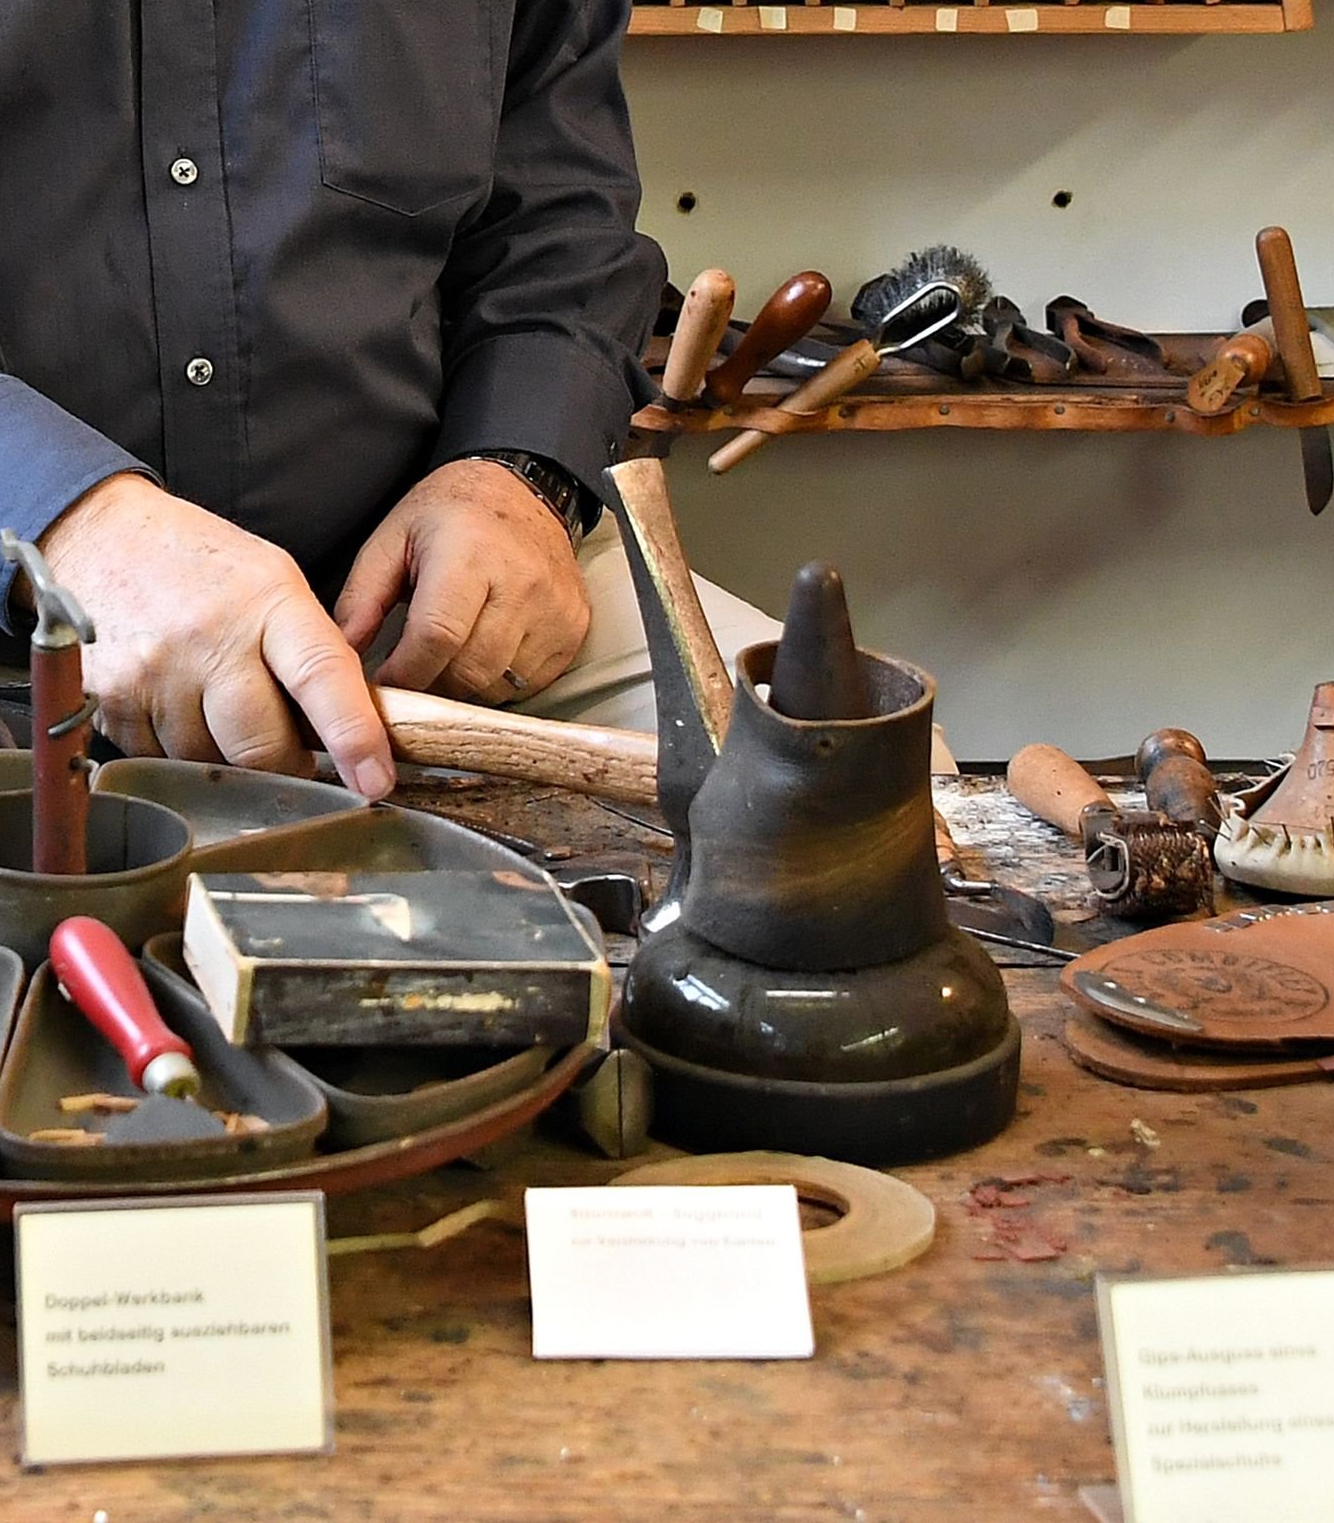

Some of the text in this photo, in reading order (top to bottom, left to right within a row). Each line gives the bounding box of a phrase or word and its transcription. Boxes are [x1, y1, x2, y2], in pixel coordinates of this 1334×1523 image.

[44, 1288, 205, 1312] Doppel-Werkbank
[45, 1320, 291, 1344] mit beidseitig ausziehbaren
